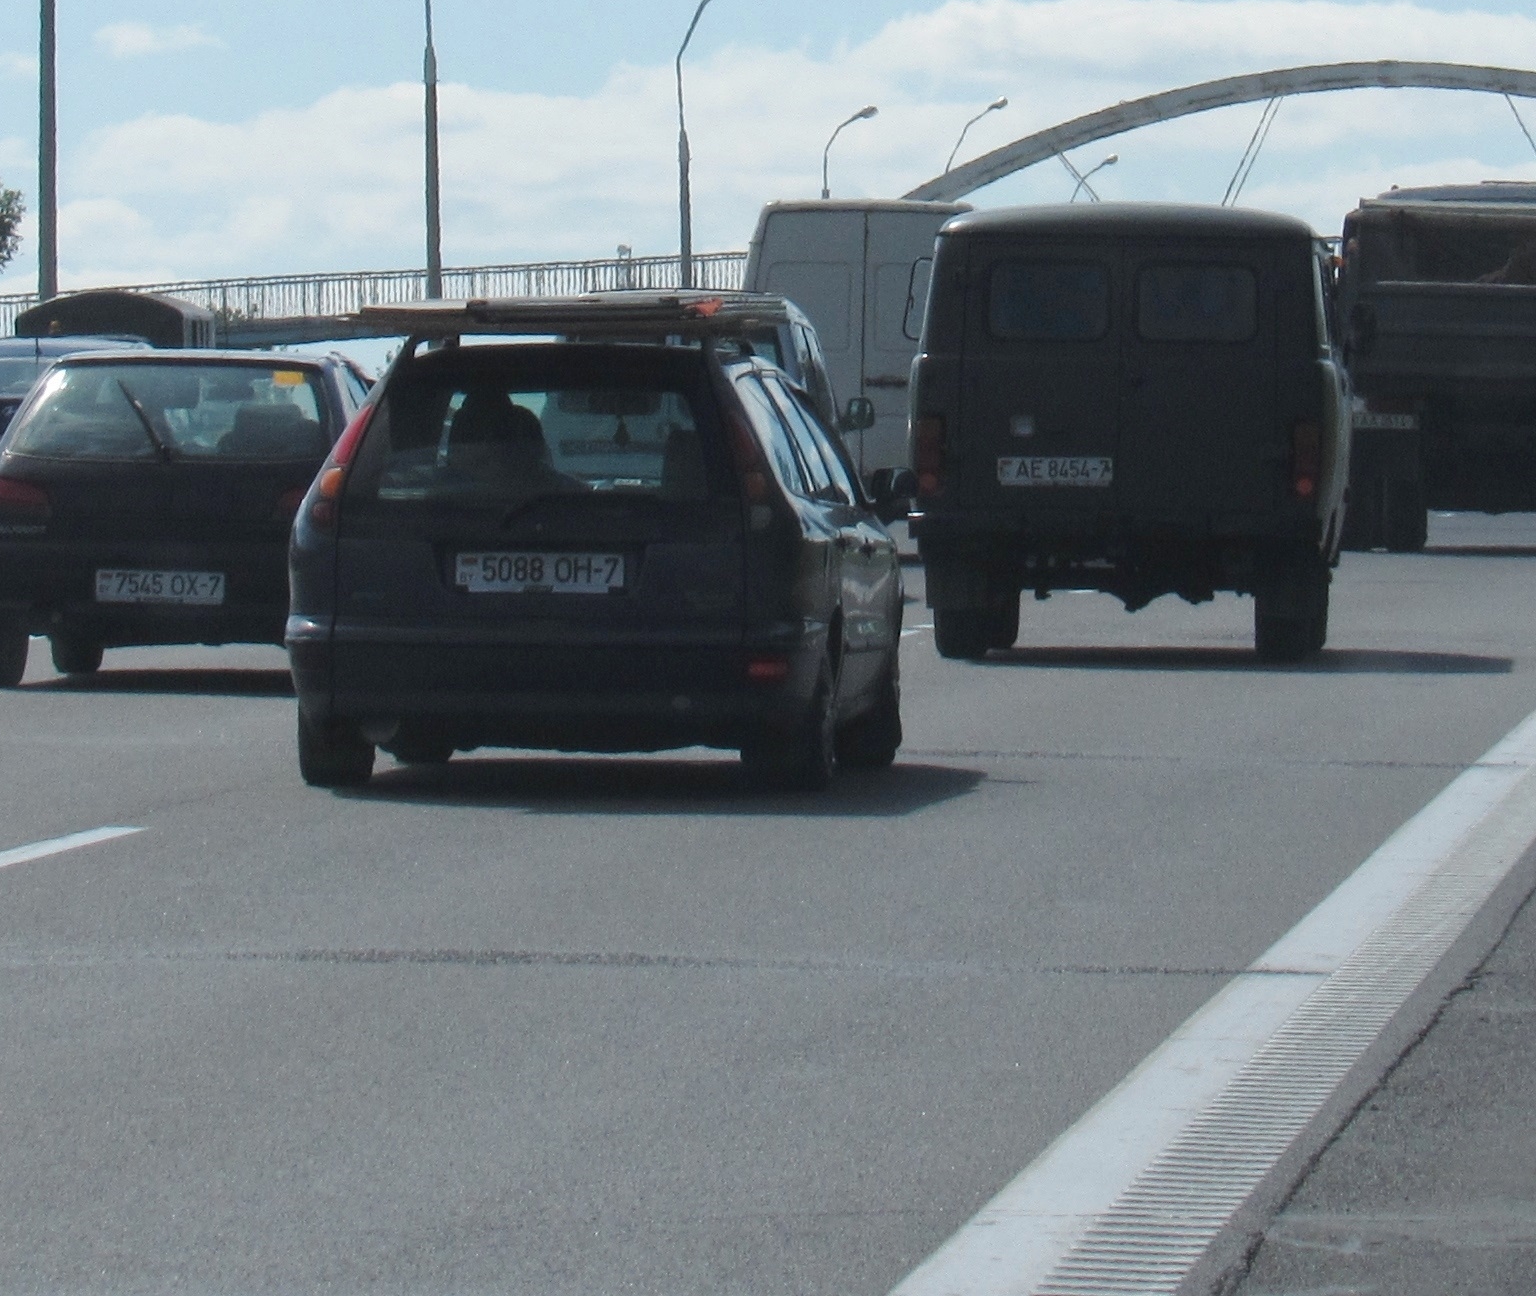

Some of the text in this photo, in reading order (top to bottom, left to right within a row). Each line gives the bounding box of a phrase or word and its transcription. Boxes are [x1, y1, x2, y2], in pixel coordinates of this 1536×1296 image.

[1016, 459, 1043, 479] AE
[482, 555, 619, 584] 5088 OH-7
[115, 571, 221, 597] 7545 OX-7
